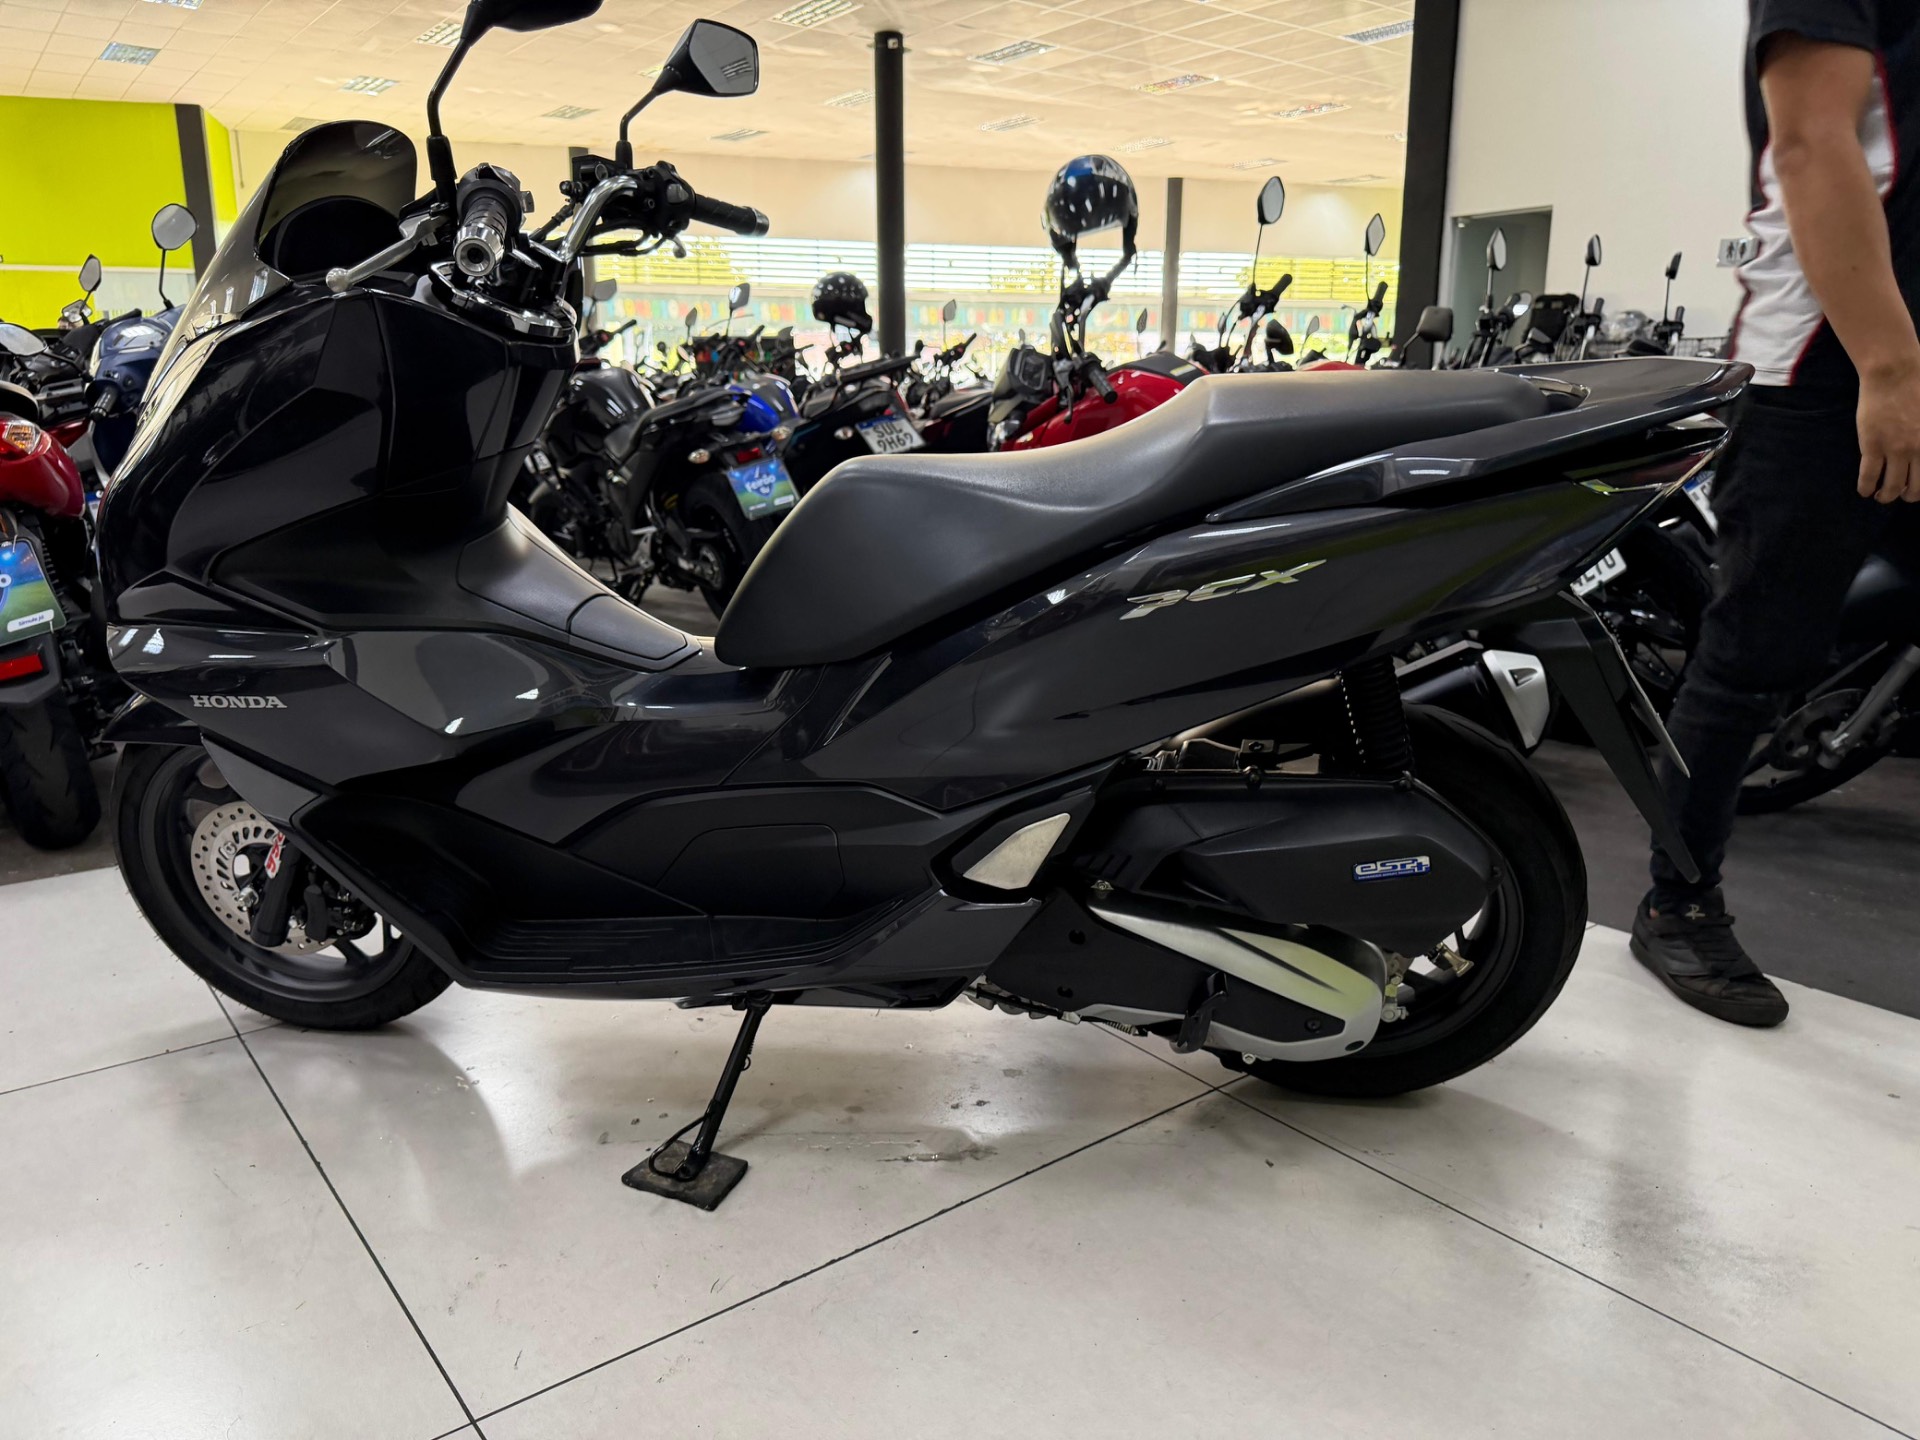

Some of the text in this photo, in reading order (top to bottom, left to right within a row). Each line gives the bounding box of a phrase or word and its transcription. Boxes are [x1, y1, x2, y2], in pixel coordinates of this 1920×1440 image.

[873, 422, 903, 438] SUL
[877, 432, 914, 452] 9H69
[1119, 559, 1328, 620] PCX
[189, 694, 288, 709] HONDA
